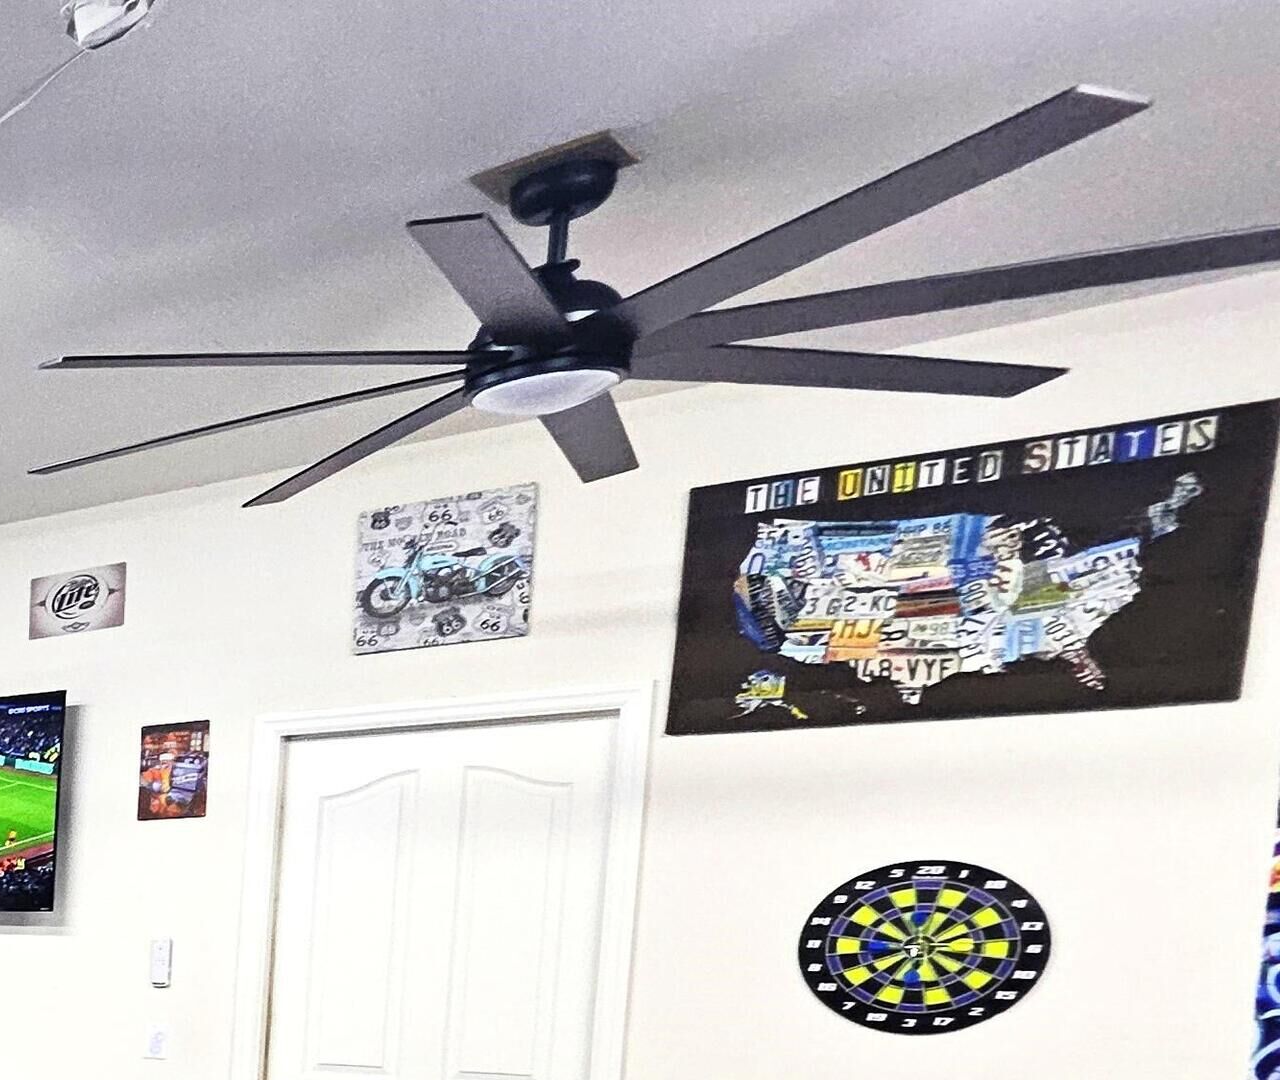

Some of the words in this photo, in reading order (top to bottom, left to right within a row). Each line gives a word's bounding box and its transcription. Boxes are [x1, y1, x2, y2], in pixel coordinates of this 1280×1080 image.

[746, 478, 818, 511] THE
[840, 452, 1003, 498] UNITED
[1023, 418, 1213, 472] STATES
[428, 509, 453, 522] 66
[55, 582, 100, 613] Lite
[479, 618, 501, 632] 66
[356, 635, 378, 647] 66
[915, 865, 946, 875] 20
[968, 1007, 984, 1016] 2
[901, 1018, 918, 1028] 3
